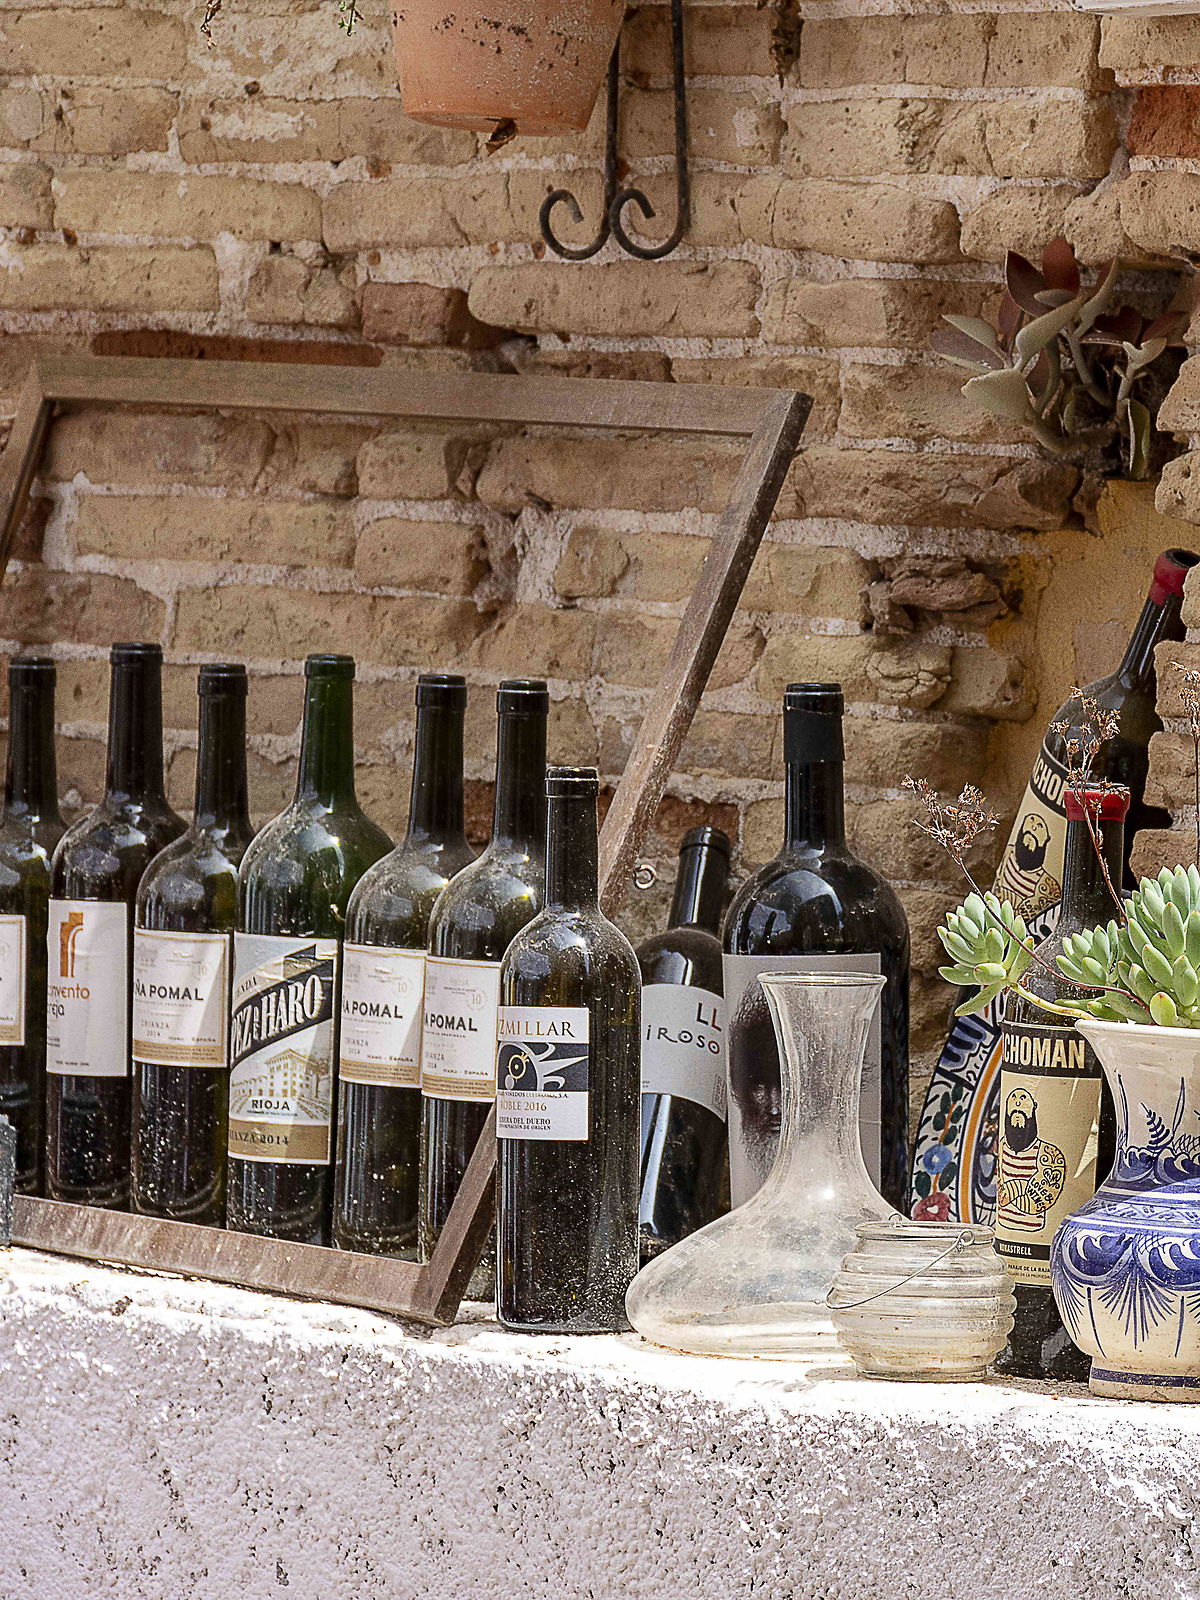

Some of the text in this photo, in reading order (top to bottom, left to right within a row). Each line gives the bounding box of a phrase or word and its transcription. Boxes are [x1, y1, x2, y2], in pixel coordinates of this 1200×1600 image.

[149, 985, 204, 1000] POMAL
[260, 975, 323, 1041] HARO
[352, 1001, 403, 1019] POMAL
[430, 1013, 478, 1032] POMAL
[499, 1019, 576, 1038] ZMILLAR
[1003, 1032, 1085, 1069] CHOMAN
[252, 1100, 290, 1111] RIOJA
[524, 1101, 547, 1111] 2016
[526, 1117, 550, 1125] DUERO
